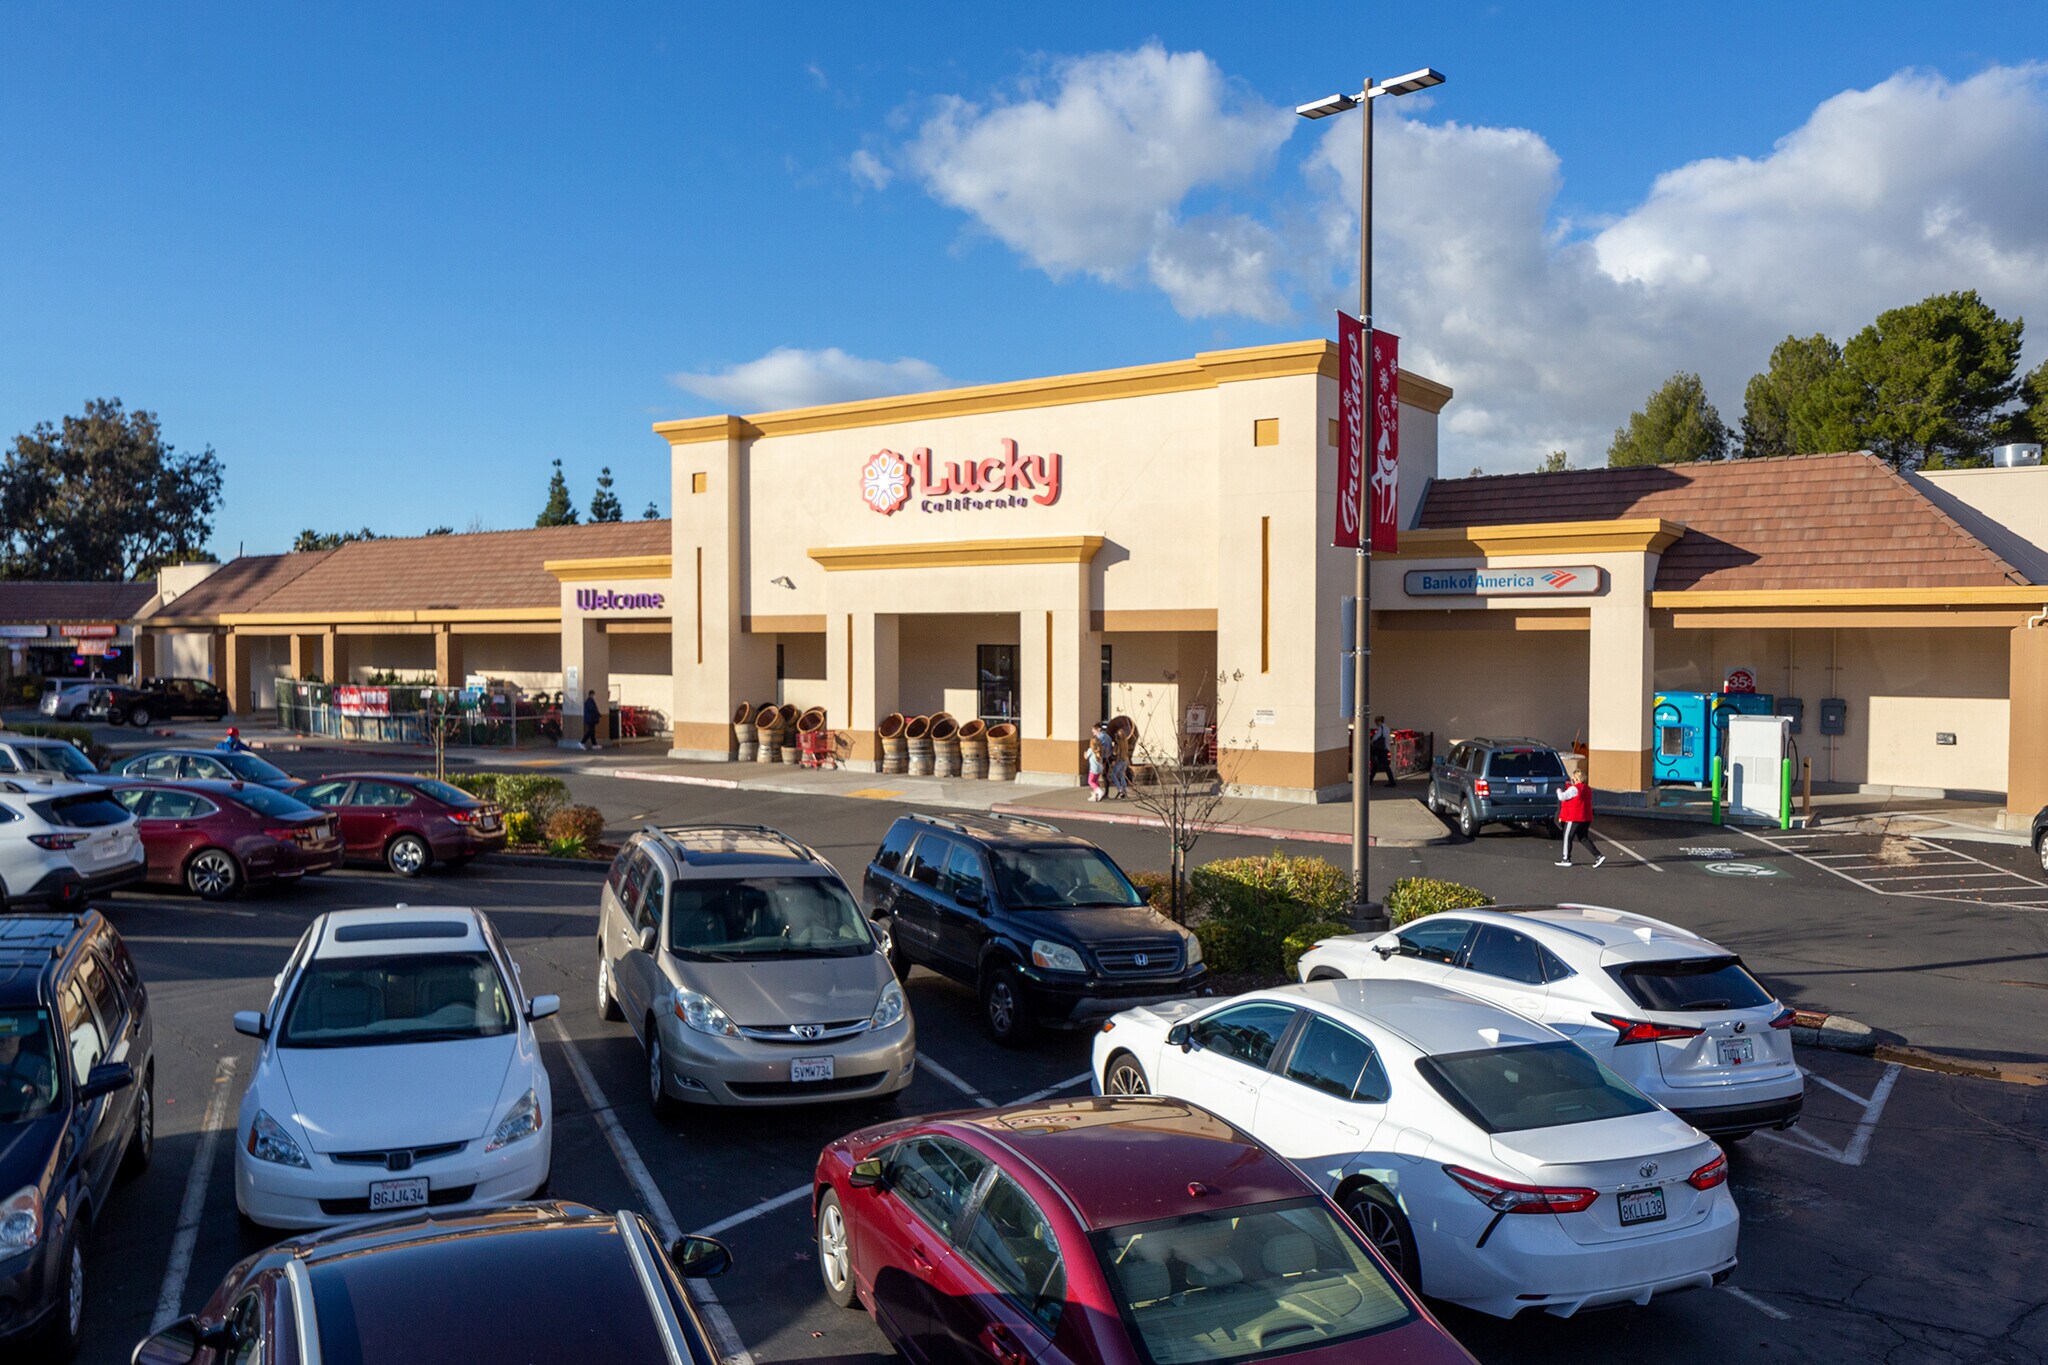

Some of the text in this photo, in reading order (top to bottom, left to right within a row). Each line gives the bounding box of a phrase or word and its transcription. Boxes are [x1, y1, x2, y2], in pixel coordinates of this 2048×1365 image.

[1342, 332, 1362, 533] Greetings
[912, 438, 1062, 506] Lucky
[921, 494, 1028, 513] California
[1423, 574, 1534, 590] Bank of America
[576, 589, 665, 611] Welcome
[794, 1066, 831, 1078] 5VMW734
[373, 1188, 424, 1205] 8GJJ434
[1622, 1199, 1663, 1220] 8KLL138
